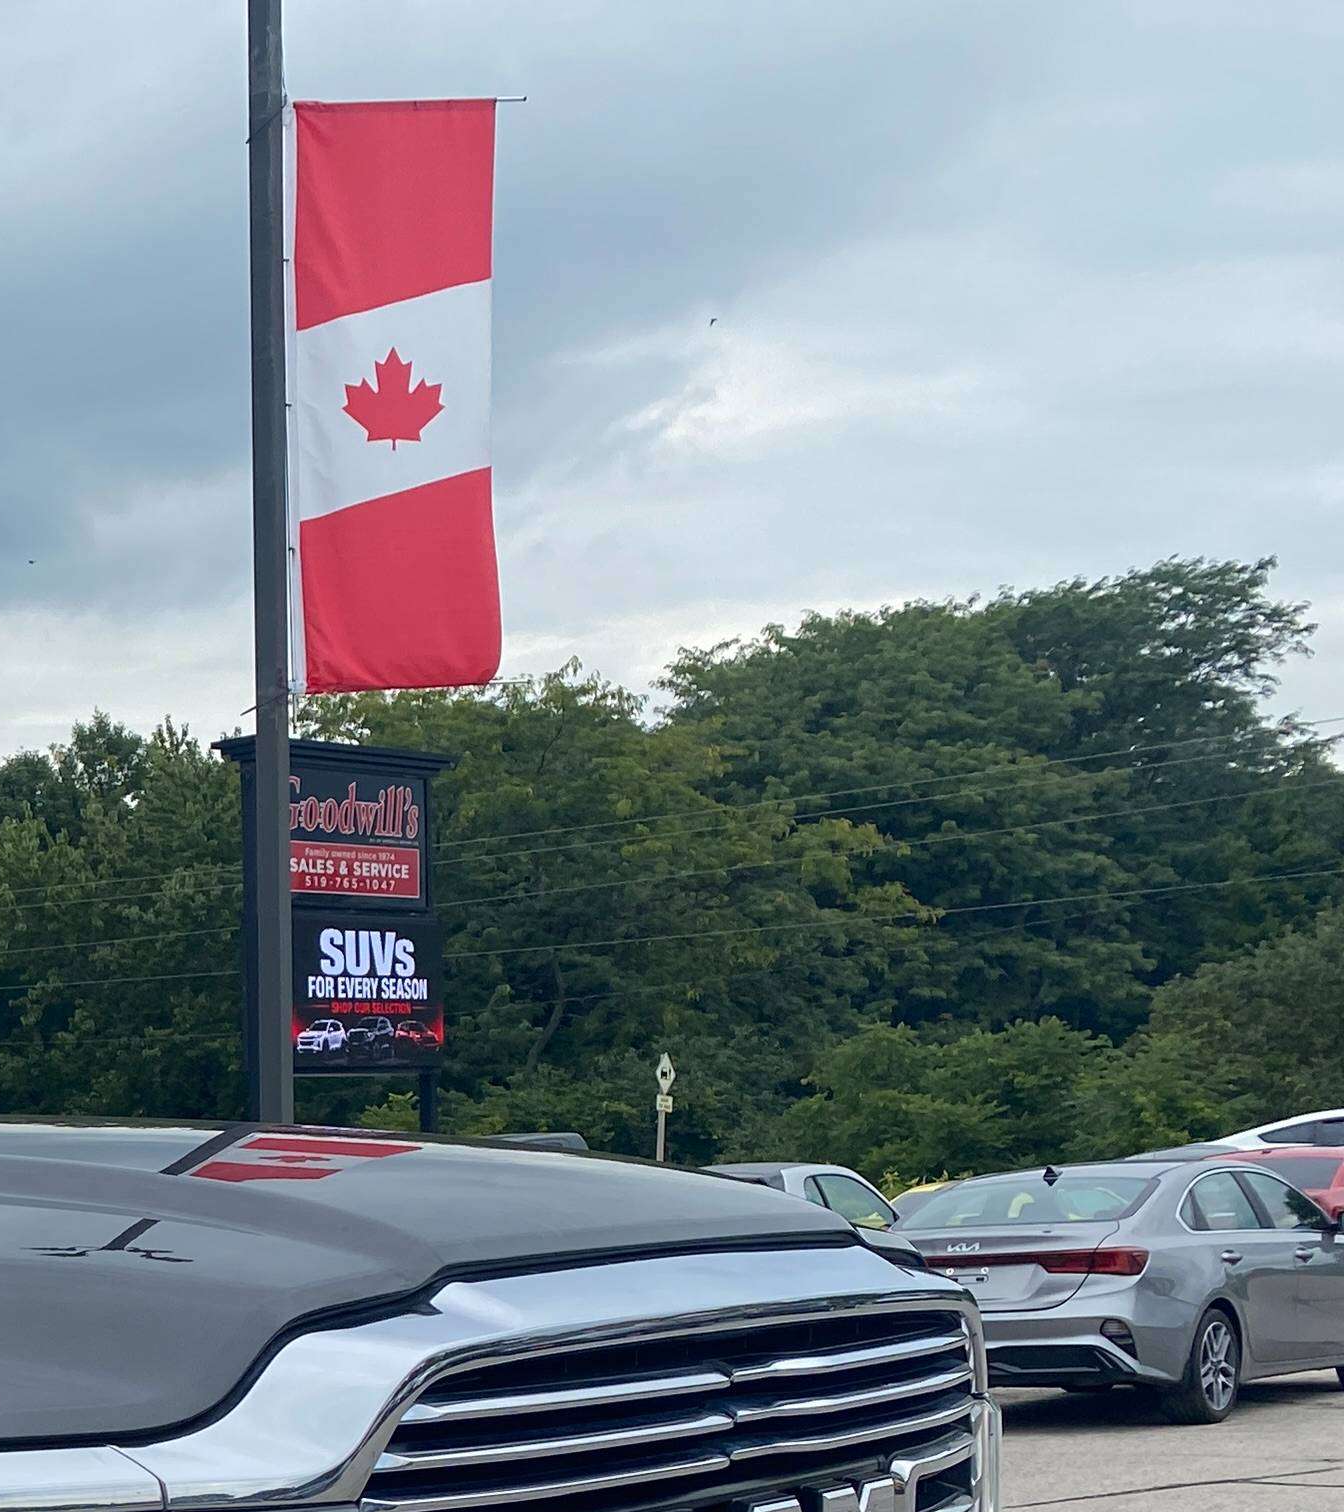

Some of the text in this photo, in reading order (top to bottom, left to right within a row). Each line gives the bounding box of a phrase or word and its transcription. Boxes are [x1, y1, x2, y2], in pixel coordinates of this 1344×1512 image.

[304, 847, 330, 859] Family
[330, 850, 356, 859] owned
[358, 851, 376, 861] since
[289, 858, 410, 879] SALES & SERVICE
[305, 875, 396, 891] 519-765-1047
[319, 928, 415, 977] SUVs
[308, 976, 427, 1000] FOR EVERY SEASON
[331, 1001, 412, 1014] SHOP OUR SELECTION
